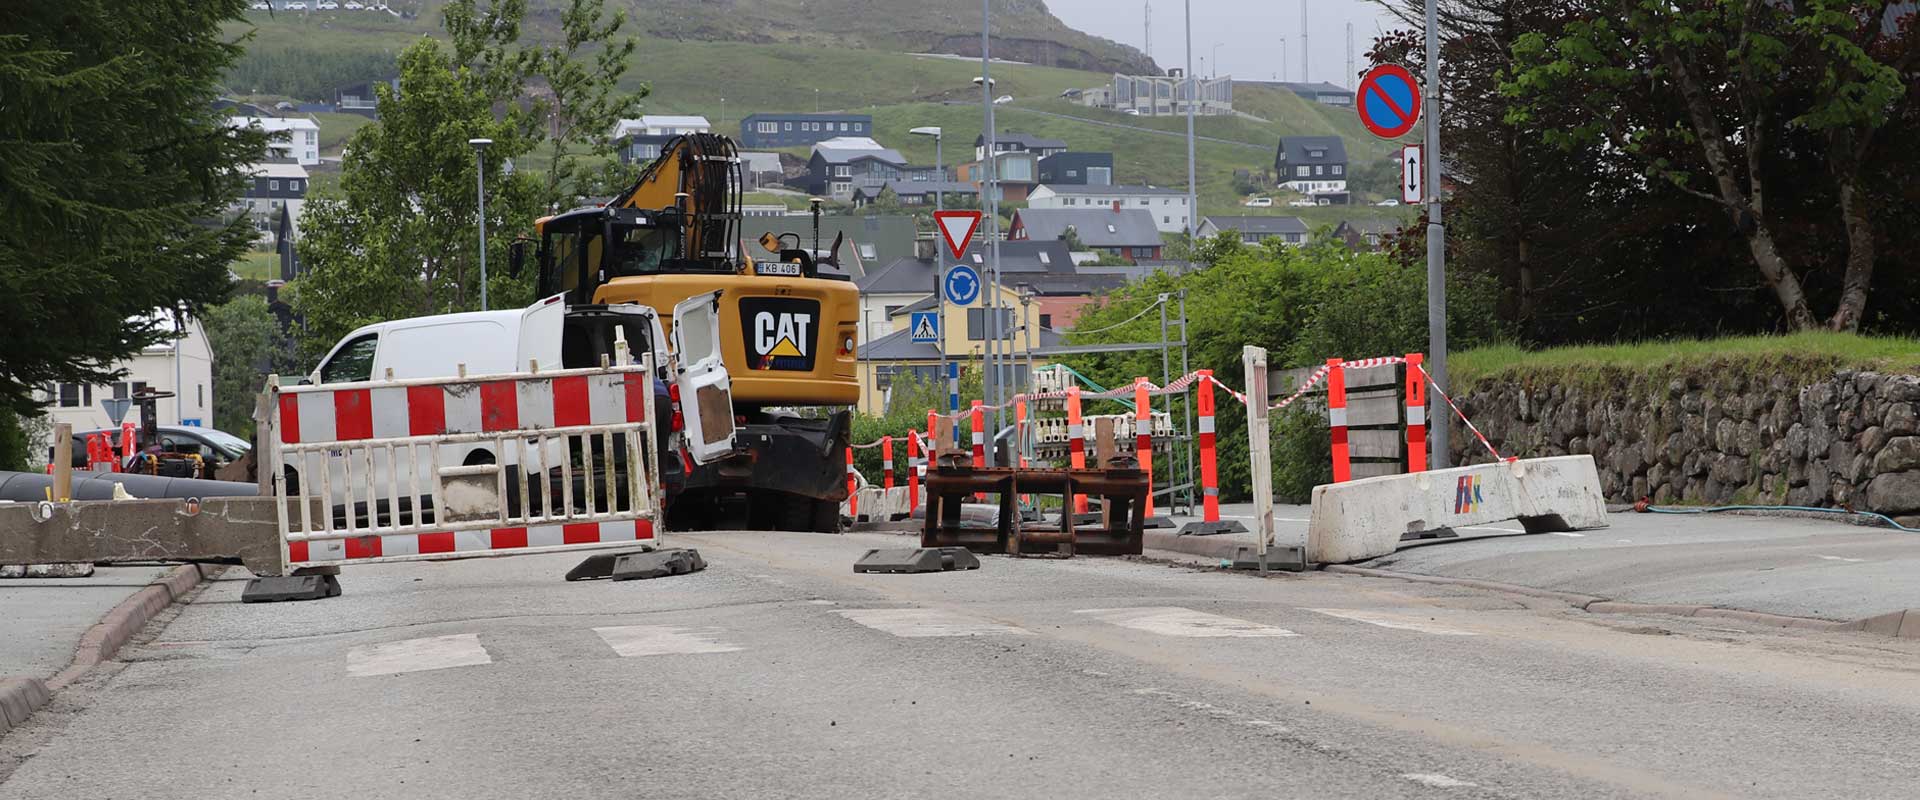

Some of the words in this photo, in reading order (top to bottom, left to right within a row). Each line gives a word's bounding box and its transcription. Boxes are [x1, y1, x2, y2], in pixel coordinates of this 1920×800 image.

[765, 263, 778, 273] KB
[781, 264, 797, 274] 406
[755, 311, 811, 357] CAT
